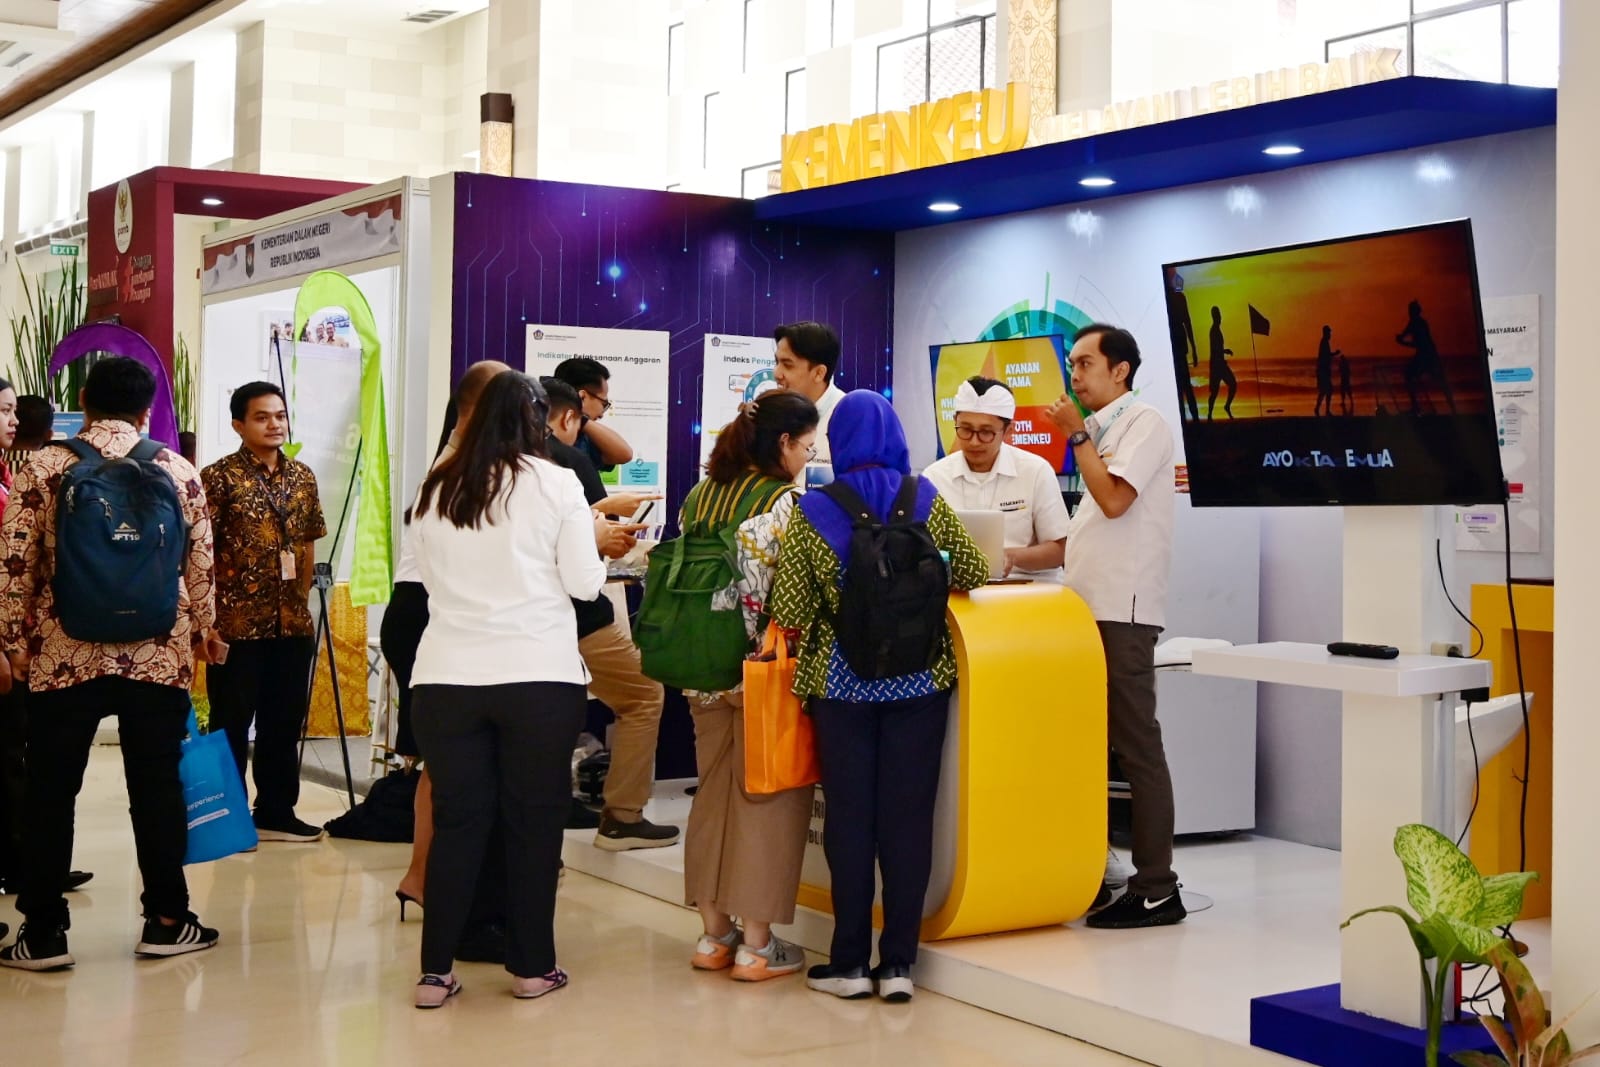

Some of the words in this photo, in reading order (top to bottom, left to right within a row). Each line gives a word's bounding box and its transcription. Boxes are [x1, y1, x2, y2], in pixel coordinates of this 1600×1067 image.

[780, 82, 1030, 193] KEMENKEU
[1190, 67, 1298, 113] LEBIH
[1300, 48, 1402, 94] BAIK
[261, 233, 294, 250] KEMENTERIAN
[311, 222, 331, 236] NEGERI
[52, 246, 77, 254] EXIT
[270, 252, 293, 268] REPUBLIK
[293, 246, 321, 262] INDONESIA
[1487, 325, 1527, 335] MASYARAKAT
[537, 352, 572, 360] Indikator
[623, 355, 661, 365] Anggaran
[723, 355, 750, 364] Indeks
[1262, 449, 1294, 467] AYO
